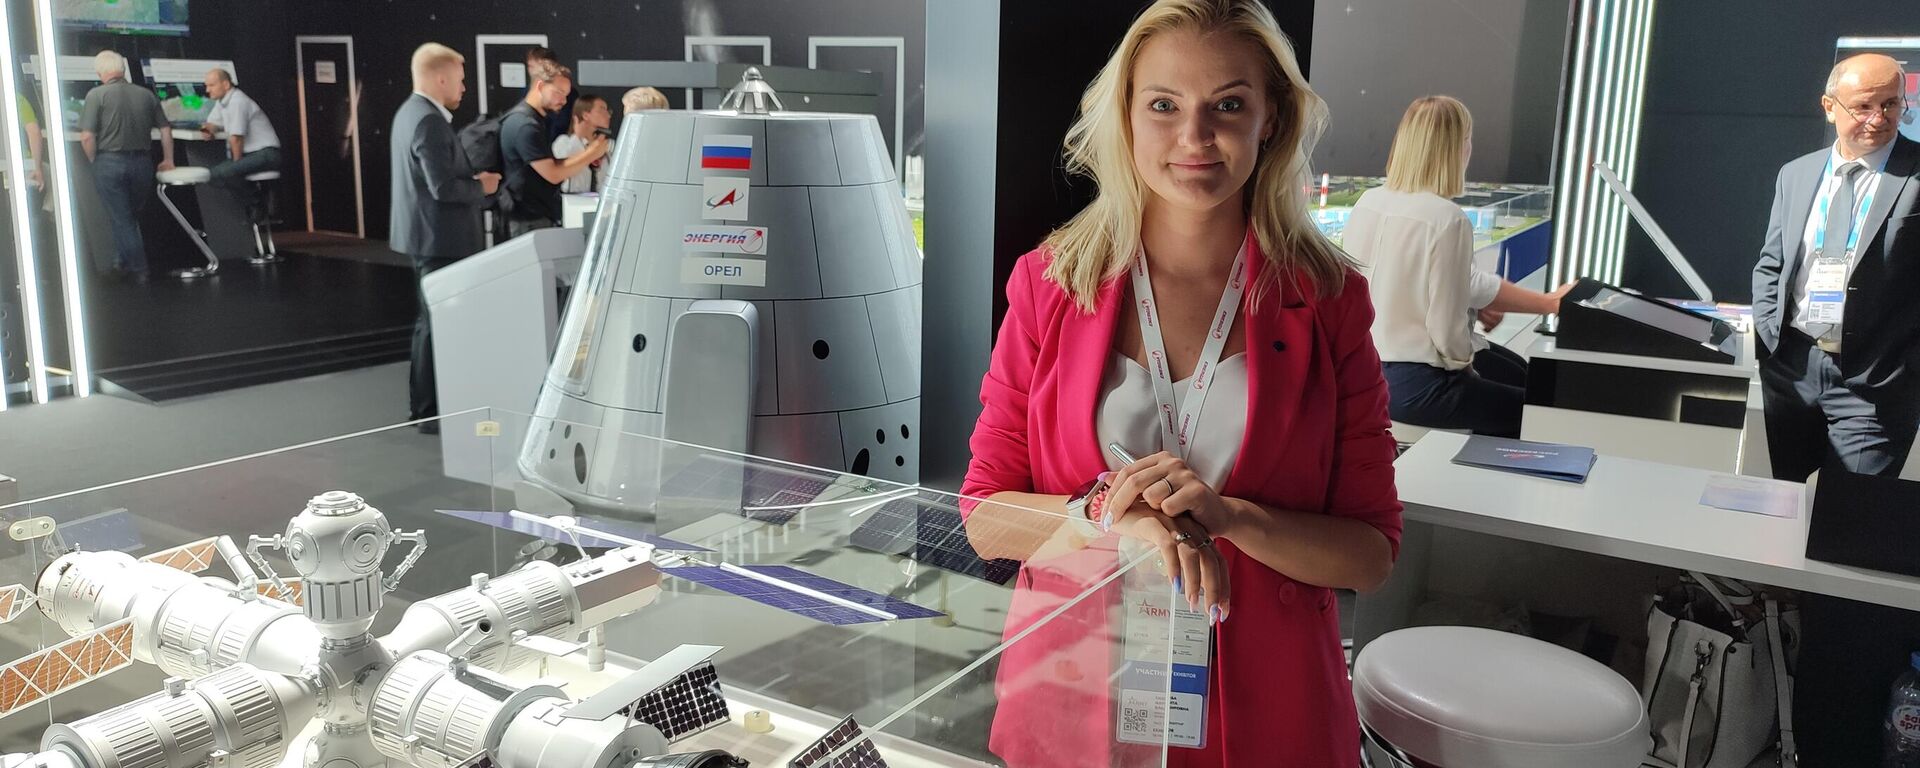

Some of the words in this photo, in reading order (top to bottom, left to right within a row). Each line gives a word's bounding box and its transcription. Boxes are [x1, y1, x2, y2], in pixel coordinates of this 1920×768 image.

[684, 233, 747, 245] ЭНЕРГИЯ
[704, 265, 742, 277] ОРЕЛ
[1135, 667, 1169, 677] УЧАСТНИ
[1900, 719, 1920, 731] spr
[1904, 714, 1920, 724] sa
